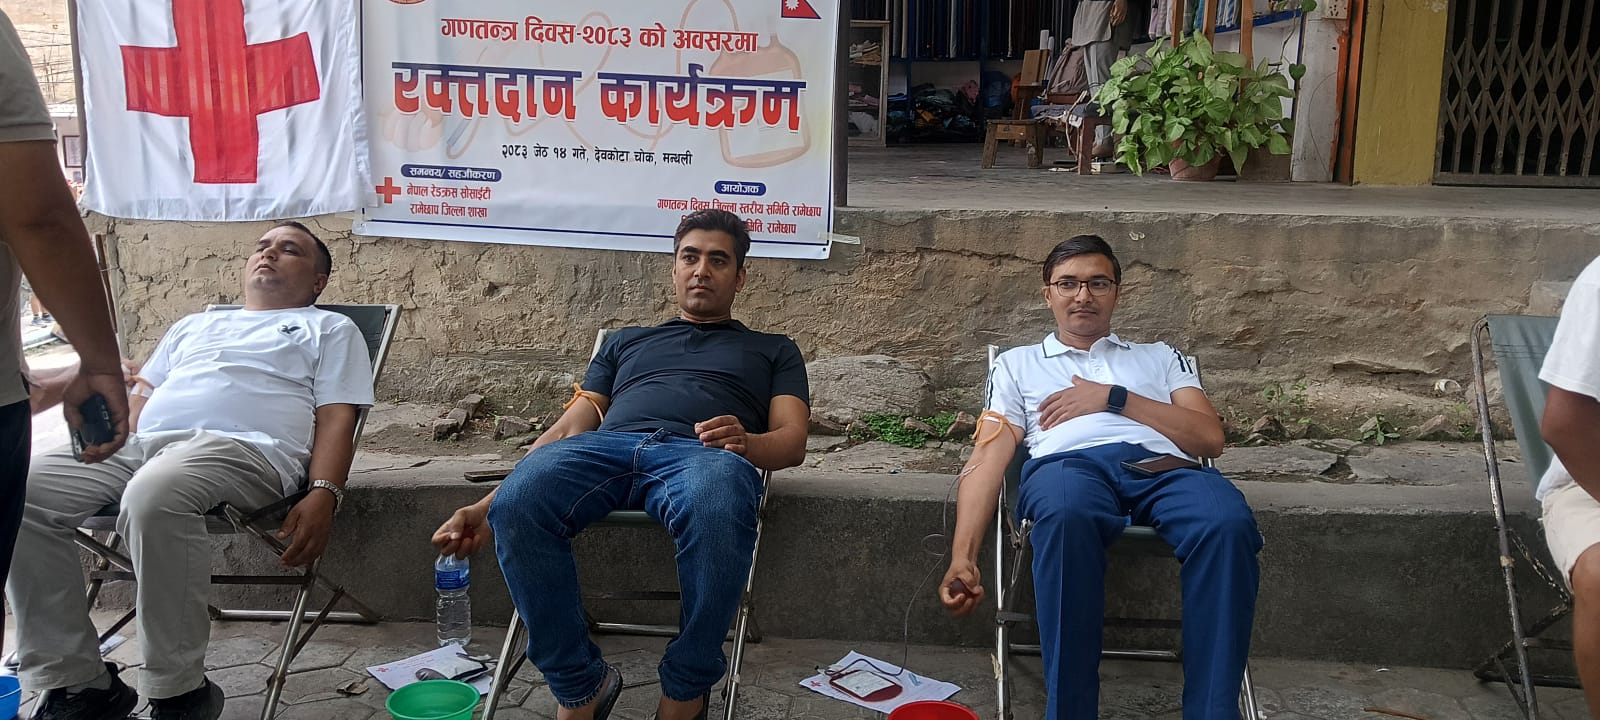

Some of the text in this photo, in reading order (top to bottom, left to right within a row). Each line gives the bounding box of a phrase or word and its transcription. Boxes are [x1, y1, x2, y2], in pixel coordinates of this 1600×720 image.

[441, 15, 759, 52] गणतन्त्र दिवस-२०८३ को अवसरमा
[392, 62, 807, 131] रक्तदान कार्यक्रम
[502, 143, 693, 165] २०८३ जेठ १४ गते, देवकोटा चोक, मन्थली
[409, 167, 496, 180] समन्वय/ सहजीकरण
[407, 183, 428, 197] नेपाल
[431, 184, 458, 198] रेडक्रस
[721, 183, 760, 193] आयोजक
[410, 202, 488, 218] रामेछाप जिल्ला शाखा
[657, 197, 822, 217] गणतन्त्र दिवस जिल्ला स्तरीय समिति रामेछाप
[767, 219, 797, 234] रामेछाप
